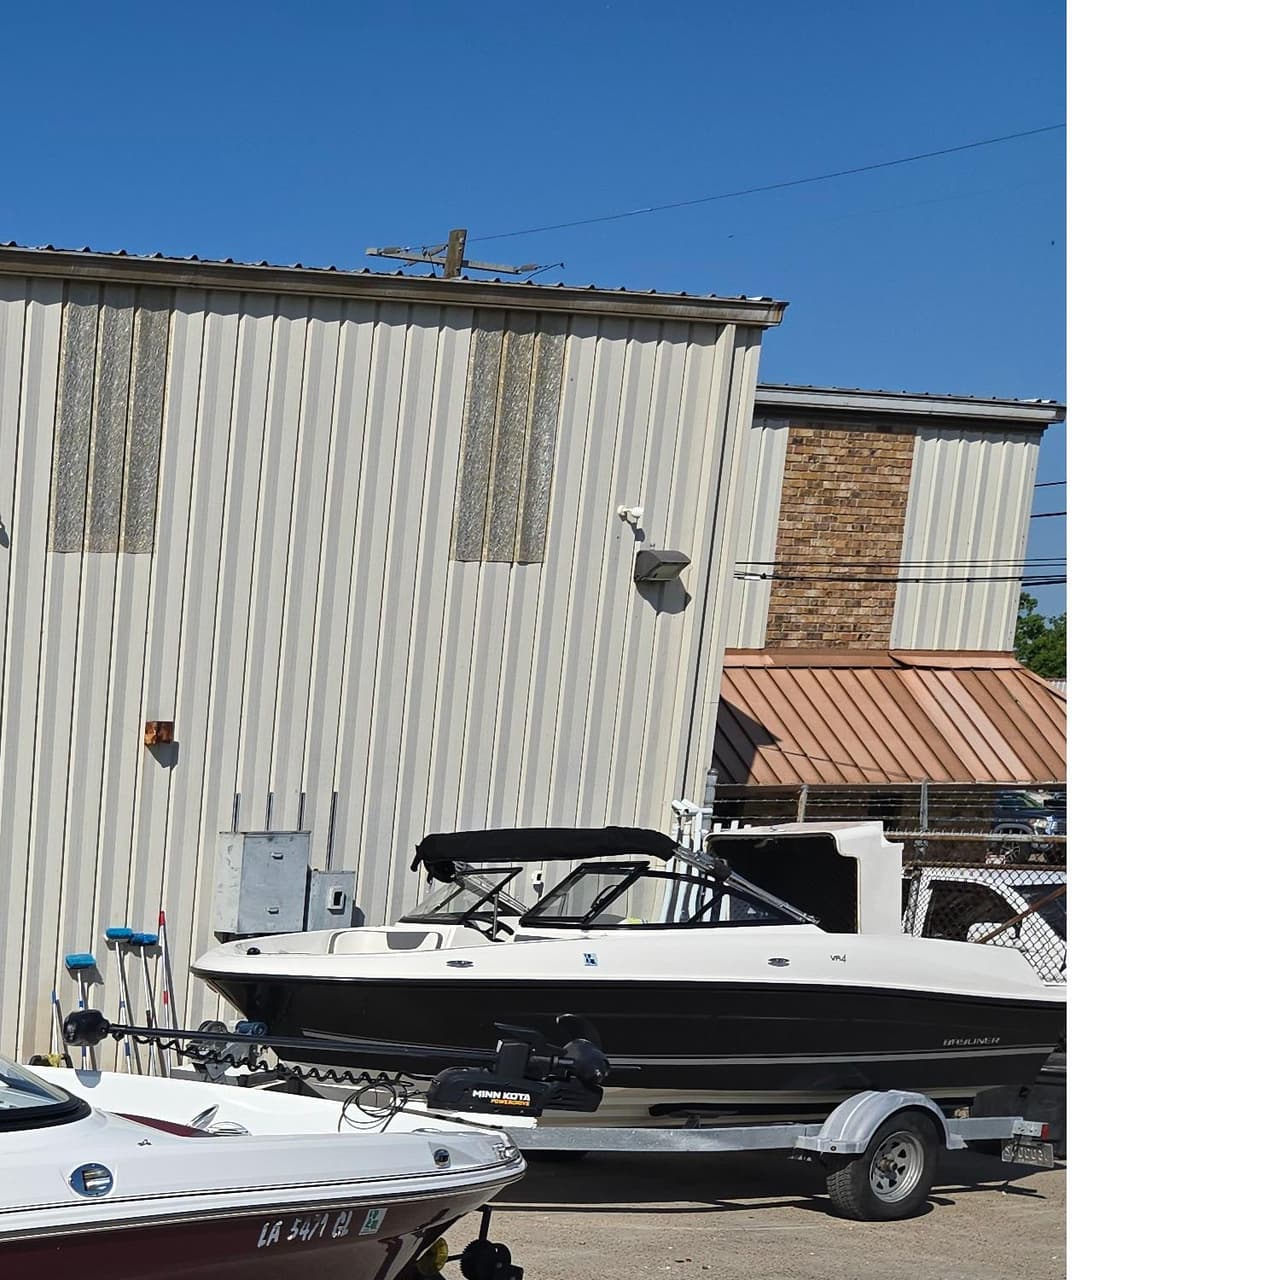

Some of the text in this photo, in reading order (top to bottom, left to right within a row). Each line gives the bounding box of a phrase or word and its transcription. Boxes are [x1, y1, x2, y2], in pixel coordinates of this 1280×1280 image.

[472, 1089, 531, 1102] MINN KOTA
[257, 1220, 283, 1248] LA
